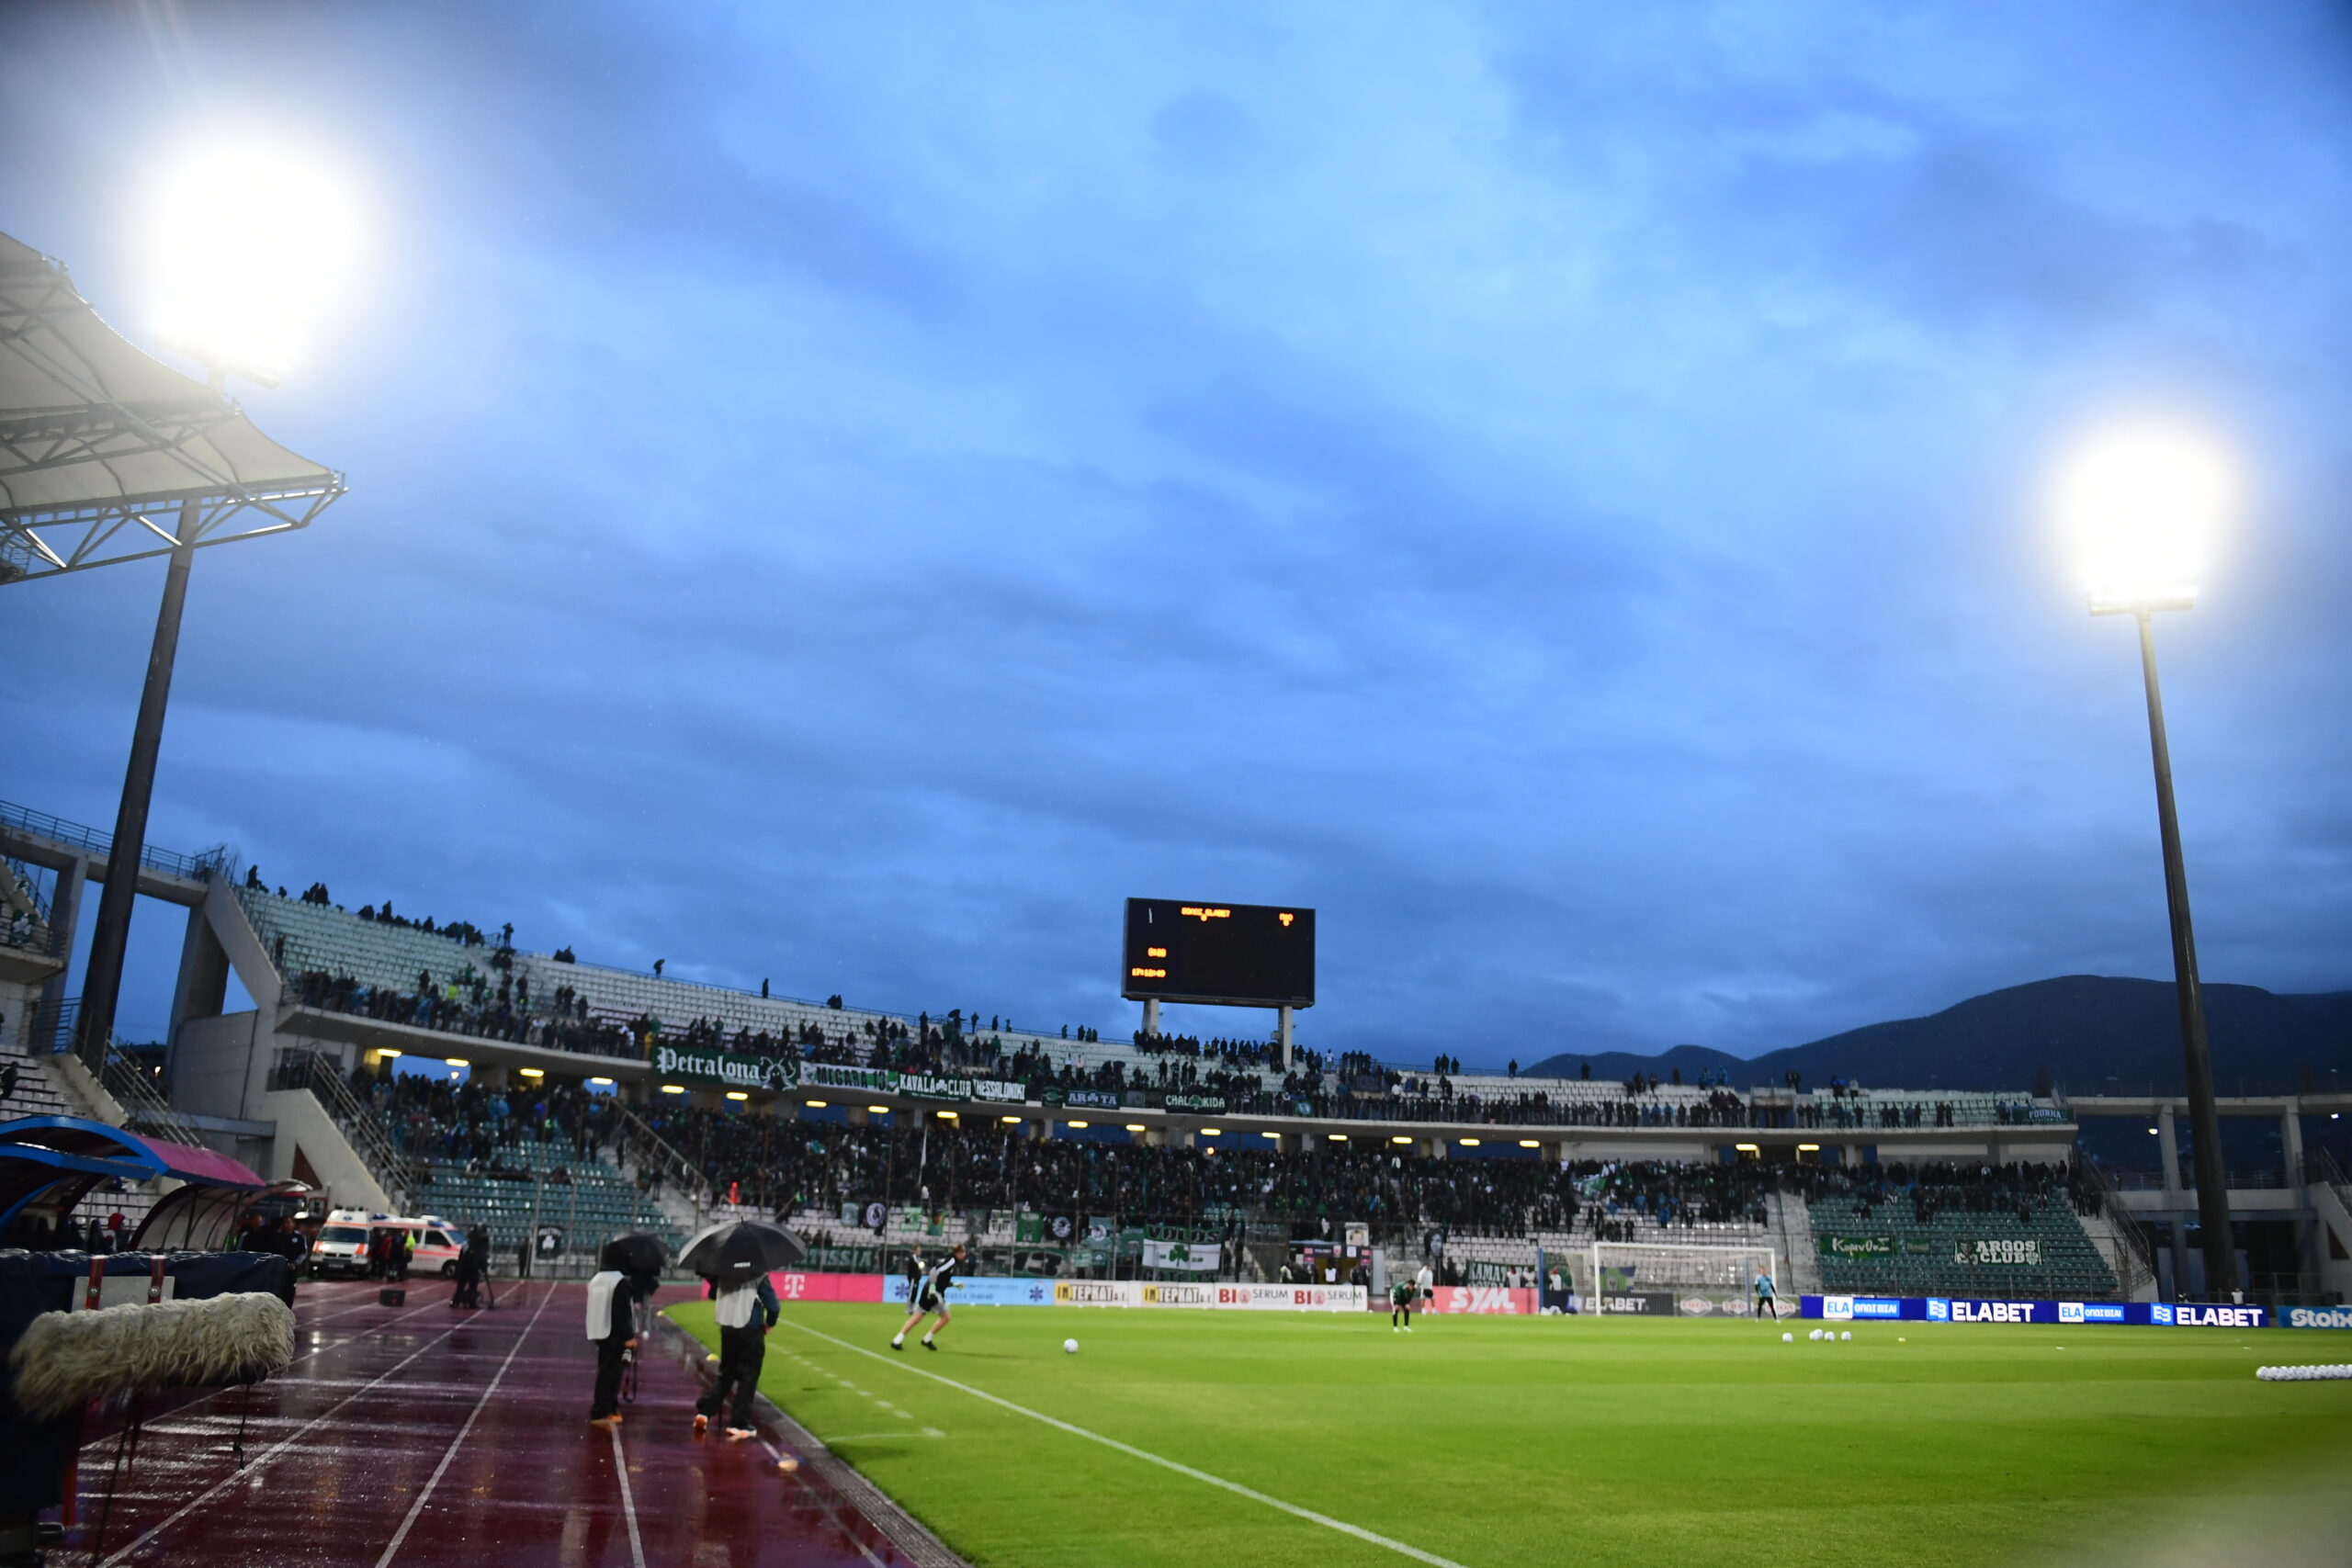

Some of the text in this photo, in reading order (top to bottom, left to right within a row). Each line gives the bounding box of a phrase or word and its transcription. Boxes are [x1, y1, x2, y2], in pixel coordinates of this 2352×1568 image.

[657, 1046, 761, 1079] Petralona
[899, 1073, 936, 1093] KAVALA
[947, 1079, 972, 1097] CLUB
[1976, 1240, 2036, 1253] ARGOS
[1980, 1252, 2025, 1264] CLUB
[1450, 1287, 1515, 1314] SYM
[1585, 1297, 1645, 1311] EABET
[1951, 1302, 2034, 1322] ELABET
[2176, 1307, 2263, 1326] ELABET
